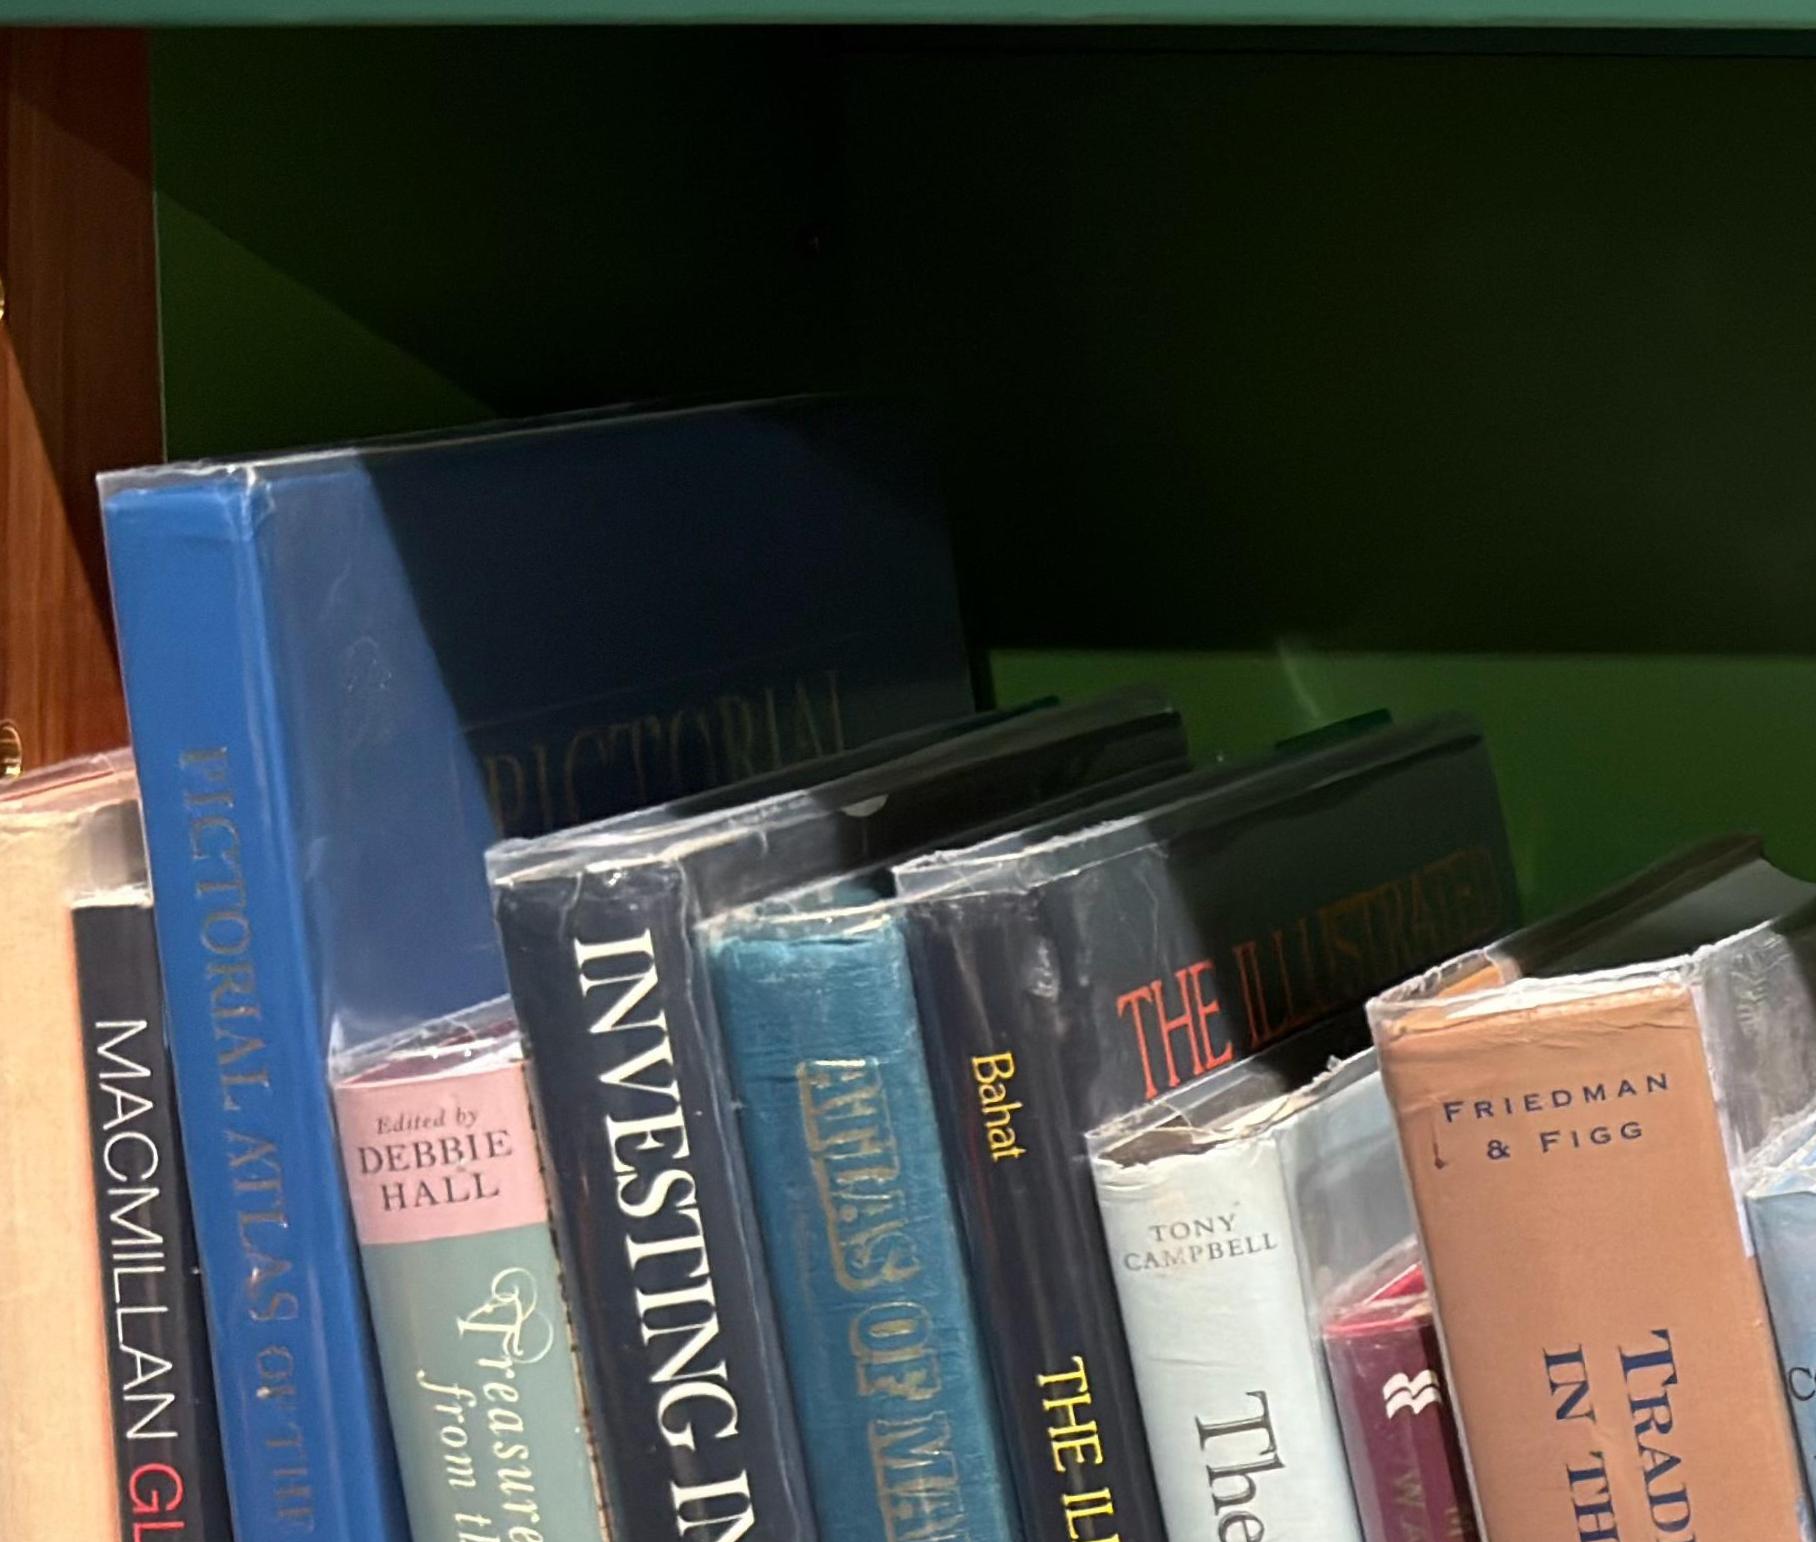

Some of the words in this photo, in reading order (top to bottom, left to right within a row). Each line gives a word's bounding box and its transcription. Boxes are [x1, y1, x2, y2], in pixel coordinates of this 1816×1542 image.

[178, 744, 273, 1111] PICTORIAL
[1116, 959, 1235, 1100] THE
[376, 1108, 446, 1135] Edited
[450, 1105, 480, 1132] by
[971, 1050, 1026, 1162] Bahat
[1444, 1072, 1671, 1125] FRIEDMAN
[1486, 1138, 1511, 1160] &
[1540, 1120, 1645, 1154] FIGG
[358, 1130, 514, 1177] DEBBIE
[380, 1171, 501, 1211] HALL
[573, 927, 740, 1454] INVESTING
[797, 1056, 905, 1293] ATLAS
[95, 1020, 178, 1441] MACMILLAN
[223, 1130, 299, 1322] ATLAS
[1124, 1231, 1278, 1274] CAMPBELL
[1150, 1211, 1238, 1243] TONY
[849, 1300, 941, 1400] OF
[1542, 1343, 1597, 1425] IN
[417, 1371, 478, 1488] from
[1036, 1356, 1103, 1472] THE
